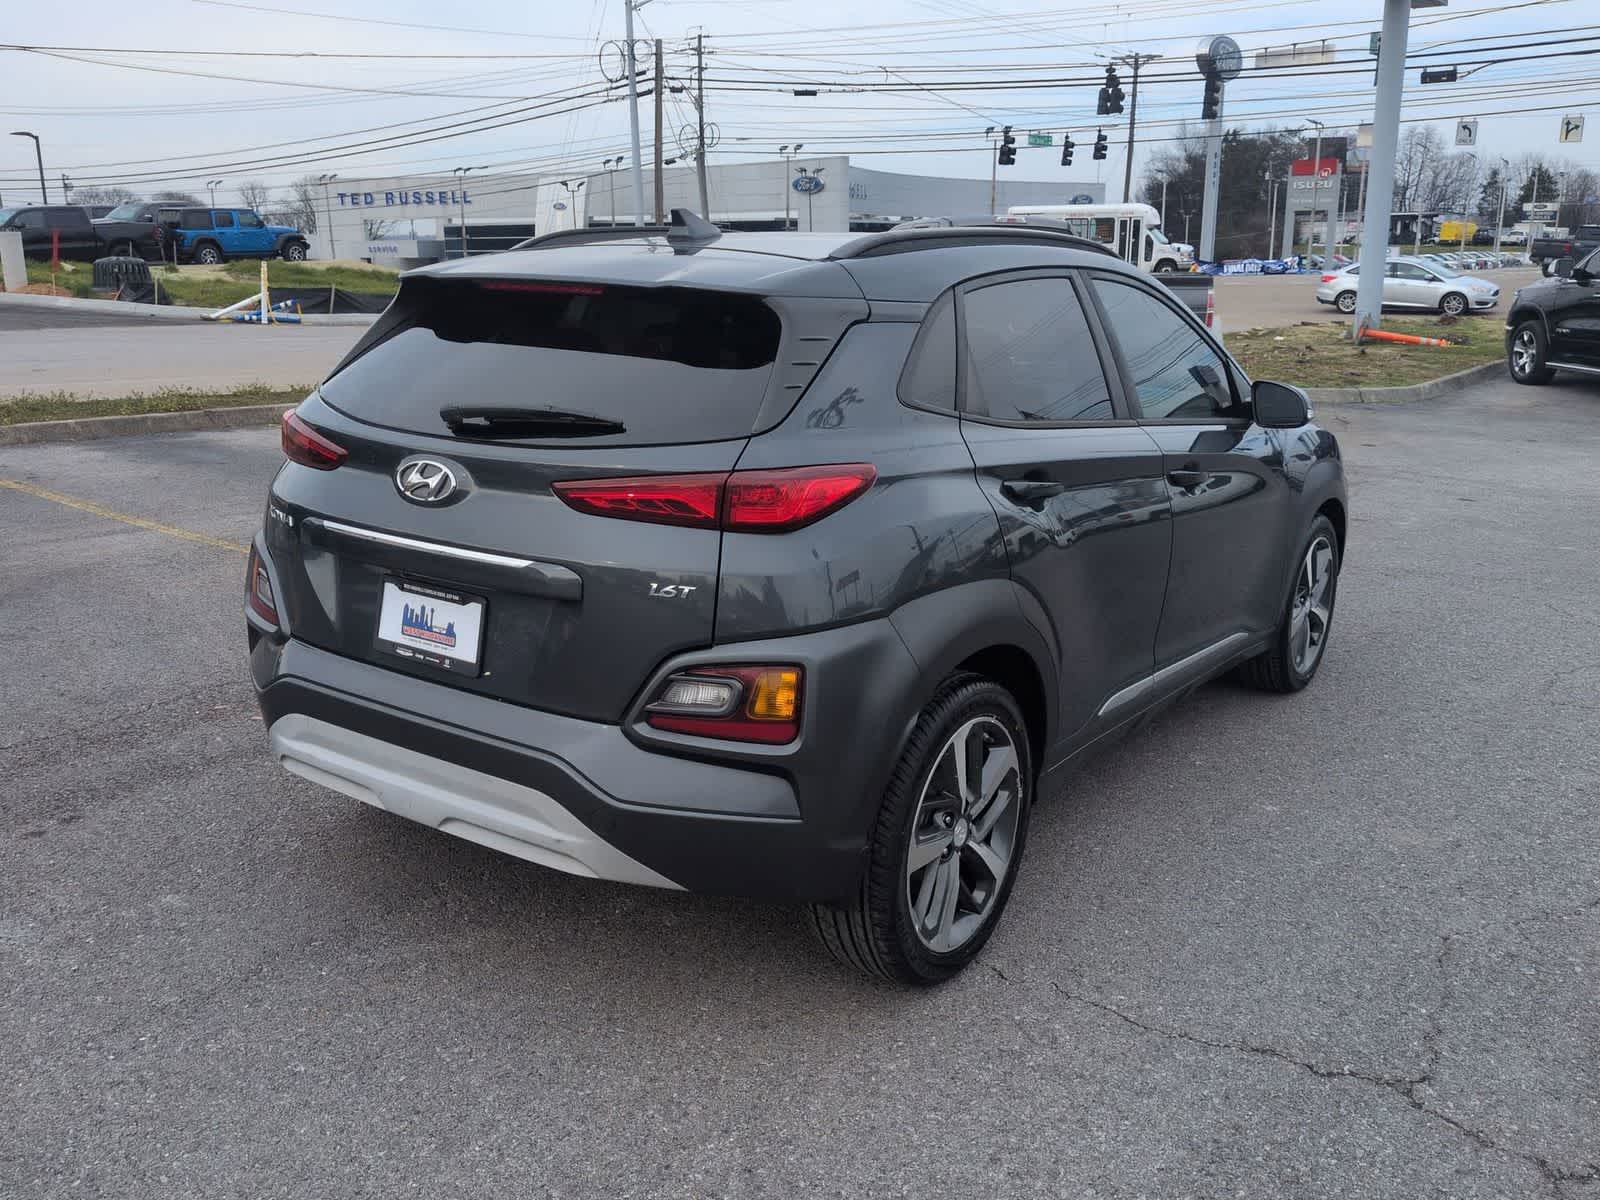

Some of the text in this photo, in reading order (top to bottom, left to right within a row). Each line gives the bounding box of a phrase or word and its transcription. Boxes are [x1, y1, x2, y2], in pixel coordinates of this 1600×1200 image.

[1293, 179, 1334, 190] ISUZU
[337, 190, 473, 206] TED RUSSELL
